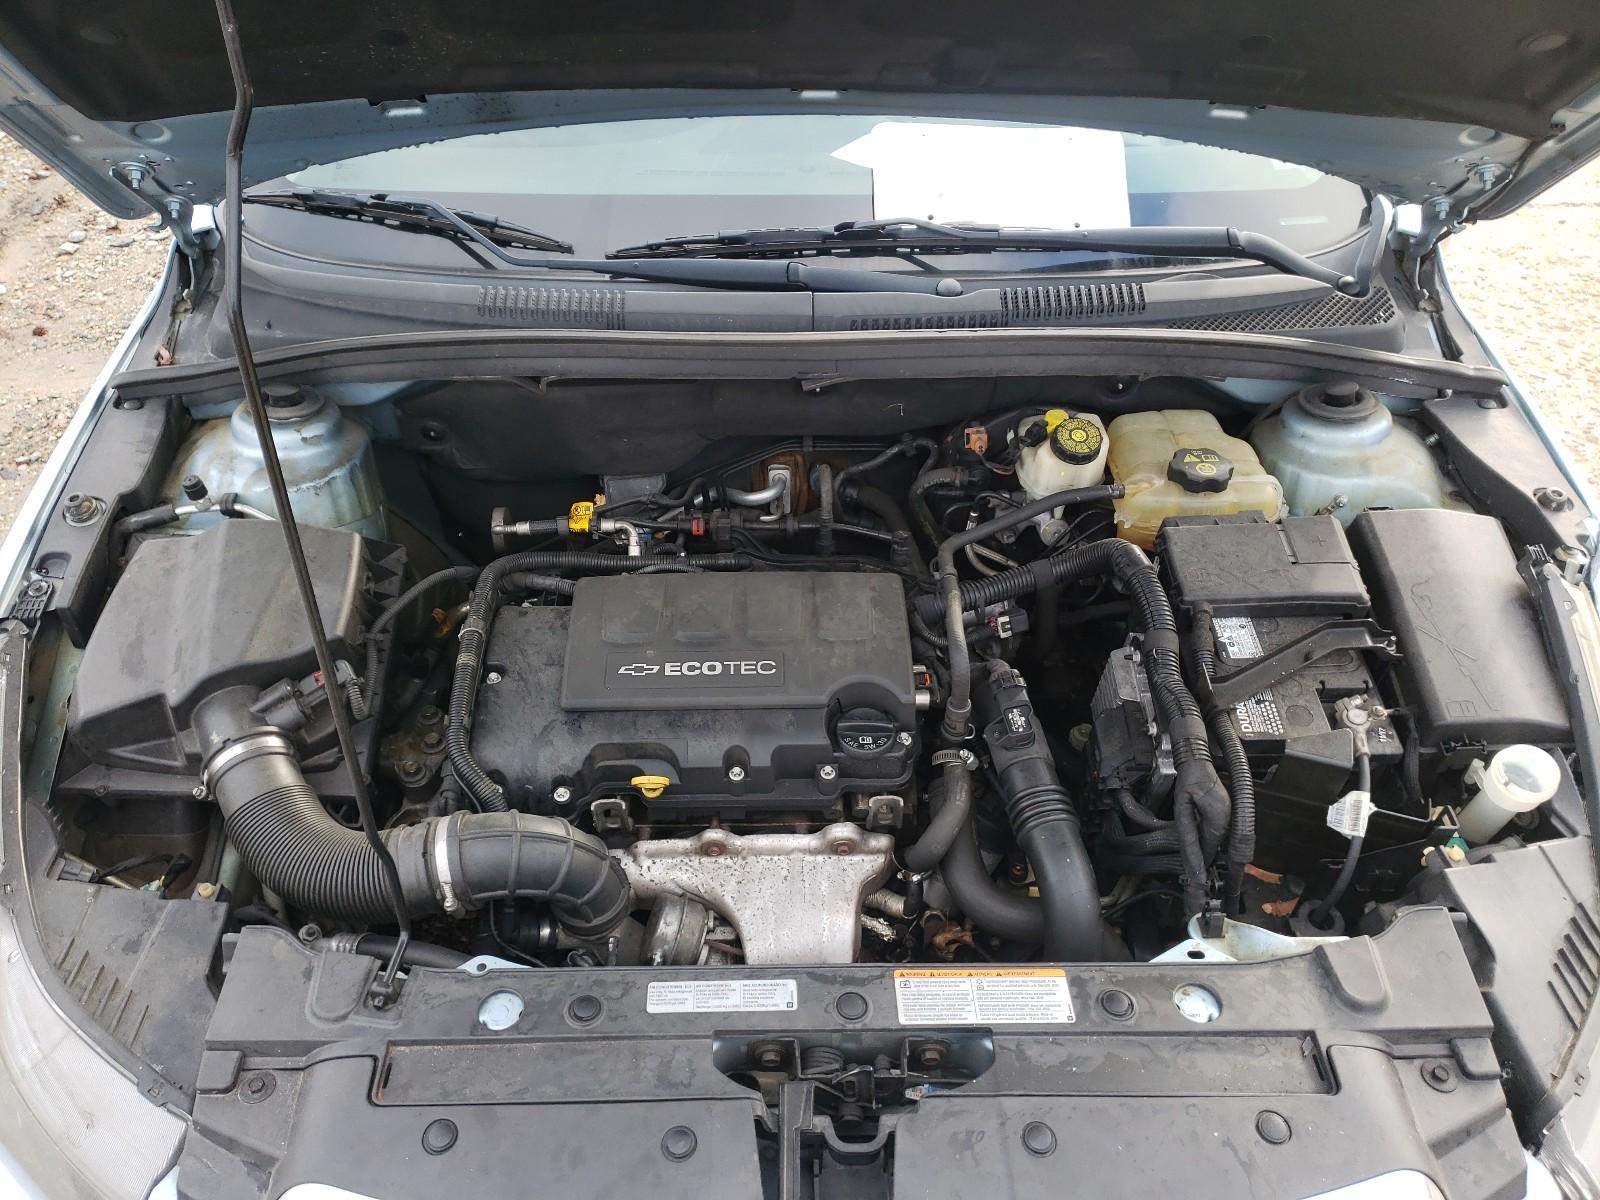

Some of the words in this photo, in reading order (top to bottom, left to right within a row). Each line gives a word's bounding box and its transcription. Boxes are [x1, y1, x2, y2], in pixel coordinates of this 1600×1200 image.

[664, 660, 777, 676] ECOTEC
[1236, 701, 1253, 732] DURA
[844, 737, 859, 749] SAE
[863, 737, 888, 750] 5W-30
